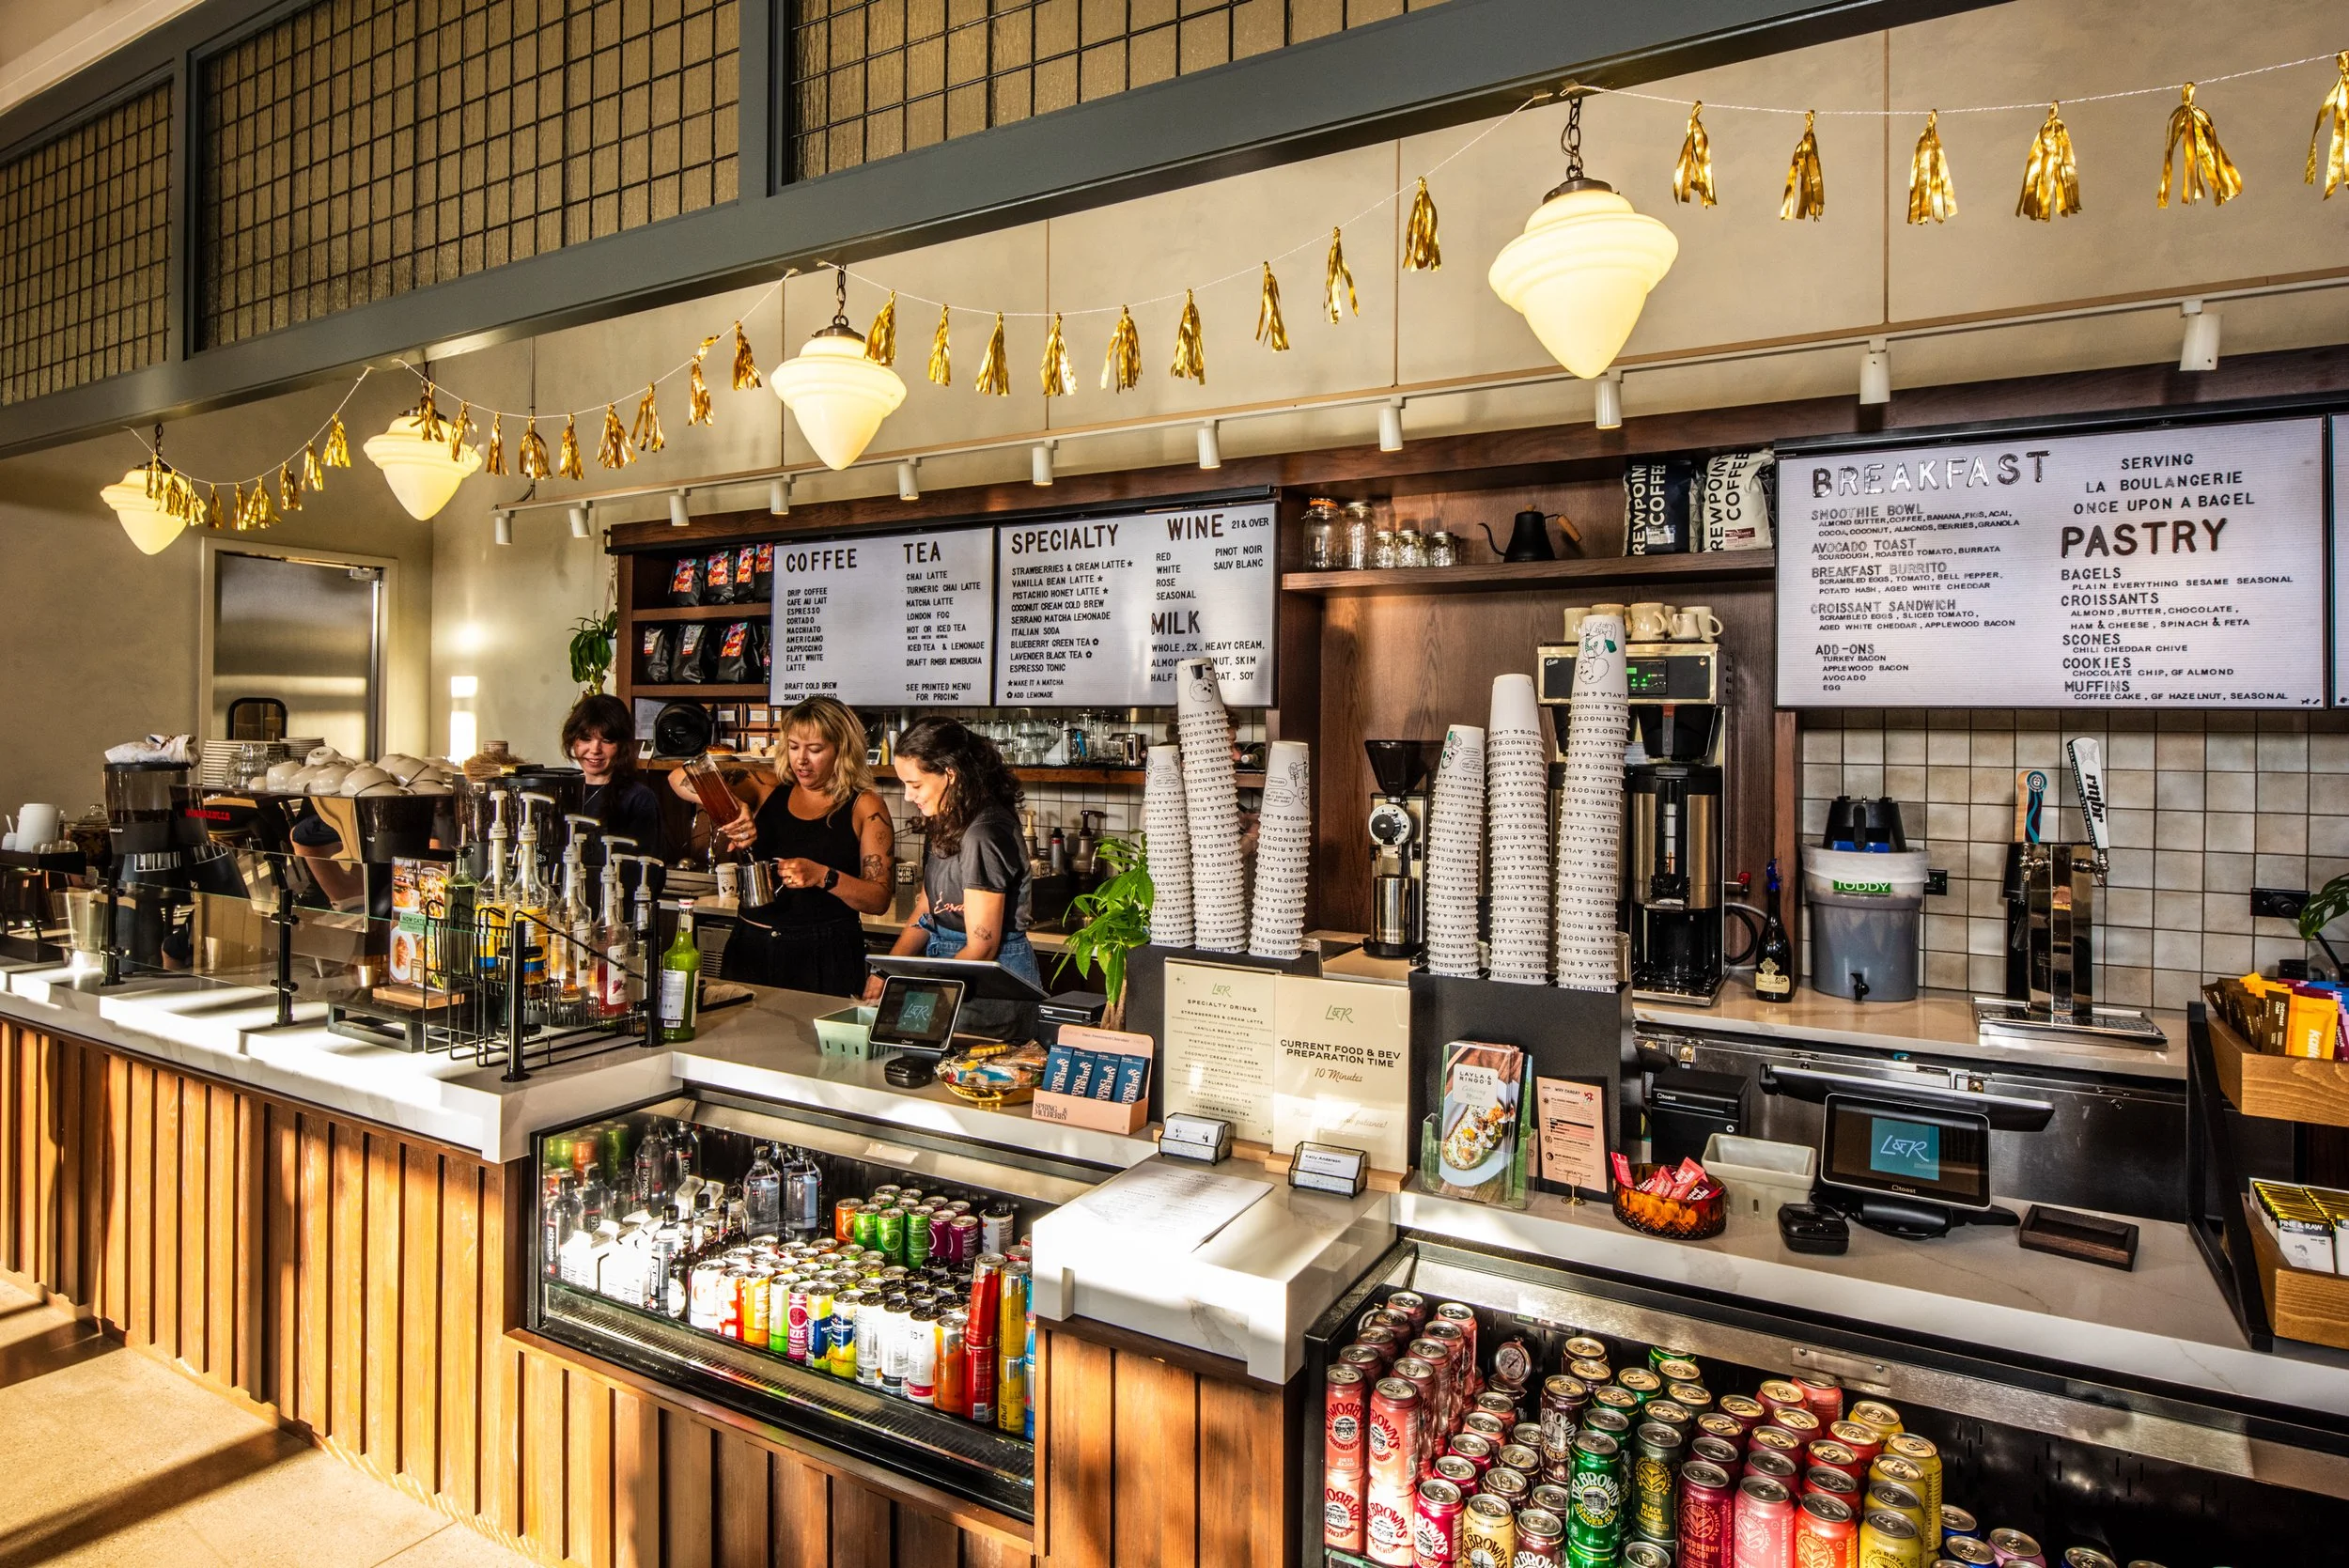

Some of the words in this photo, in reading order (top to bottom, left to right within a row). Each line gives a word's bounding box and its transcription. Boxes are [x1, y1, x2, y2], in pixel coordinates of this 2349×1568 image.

[2122, 454, 2193, 470] SERVING
[1812, 450, 2050, 498] BREAKFAST
[1725, 453, 1750, 520] COFFEE
[2086, 481, 2105, 493] LA
[2120, 472, 2242, 490] BOULANGERIE
[1649, 465, 1666, 526] COFFEE
[2074, 501, 2119, 515] ONCE
[2127, 497, 2172, 511] UPON
[2181, 496, 2191, 508] A
[2198, 493, 2254, 507] BAGEL
[1812, 505, 1879, 520] SMOOTHIE
[1888, 504, 1923, 517] BOWL
[1167, 513, 1224, 541] WINE
[1249, 517, 1268, 528] OVER
[1011, 523, 1118, 554] SPECIALTY
[2061, 518, 2227, 558] PASTRY
[1216, 547, 1237, 556] PINOT
[1242, 545, 1263, 554] NOIR
[1812, 541, 1867, 554] AVOCADO
[1875, 538, 1917, 551] TOAST
[903, 541, 941, 564] TEA
[1156, 552, 1171, 561] RED
[786, 548, 857, 572] COFFEE
[1214, 561, 1233, 570] SAUV
[1236, 559, 1263, 568] BLANC
[1157, 565, 1180, 574] WHITE
[1812, 565, 1882, 578] BREAKFAST
[1890, 562, 1947, 575] BURRITO
[2061, 567, 2121, 581] BAGELS
[1013, 577, 1043, 587] VANILLA
[1047, 576, 1066, 585] BEAN
[1070, 575, 1094, 583] LATTE
[1157, 579, 1175, 587] ROSE
[2113, 581, 2178, 589] EVERYTHING
[2237, 576, 2293, 584] SEASONAL
[804, 587, 828, 596] COFFEE
[907, 585, 939, 594] TURMERIC
[961, 582, 980, 591] LATTE
[1013, 590, 1049, 599] PISTACHIO
[1050, 588, 1073, 598] HONEY
[1077, 587, 1099, 596] LATTE
[1157, 590, 1196, 599] SEASONAL
[2061, 593, 2159, 606] CROISSANTS
[815, 597, 827, 605] LAIT
[933, 598, 954, 606] LATTE
[1811, 601, 1881, 614] CROISSANT
[1889, 599, 1955, 612] SANDWICH
[787, 607, 820, 615] ESPRESSO
[1011, 614, 1042, 624] SERRANO
[1045, 613, 1071, 623] MATCHA
[1074, 612, 1111, 621] LEMONADE
[1151, 610, 1201, 635] MILK
[1012, 628, 1039, 637] ITALIAN
[1043, 627, 1060, 635] SODA
[786, 635, 823, 644] AMERICANO
[2062, 634, 2121, 645] SCONES
[1011, 651, 1043, 660] LAVENDER
[1046, 651, 1066, 660] BLACK
[1068, 650, 1082, 659] TEA
[1010, 663, 1044, 673] ESPRESSO
[1047, 663, 1066, 672] TONIC
[2062, 658, 2131, 669] COOKIES
[2064, 681, 2130, 692] MUFFINS
[1188, 1000, 1226, 1008] SPECIALTY
[1230, 1004, 1257, 1013] DRINKS
[1325, 1004, 1353, 1023] L&R
[1281, 1040, 1330, 1051] CURRENT
[1335, 1045, 1363, 1055] FOOD
[1367, 1048, 1375, 1057] &
[1377, 1049, 1401, 1059] BEV
[1286, 1049, 1363, 1063] PREPARATION
[1368, 1058, 1394, 1067] TIME
[1315, 1068, 1324, 1078] 10
[1327, 1071, 1363, 1082] Minutes
[1459, 1077, 1492, 1085] RINGO'S
[1035, 1103, 1057, 1111] SPRING
[1034, 1110, 1066, 1120] MULBERRY
[1880, 1135, 1929, 1162] L&R
[789, 1329, 805, 1339] IZZE
[1641, 1503, 1661, 1514] BLACK
[1641, 1510, 1663, 1522] LEMON
